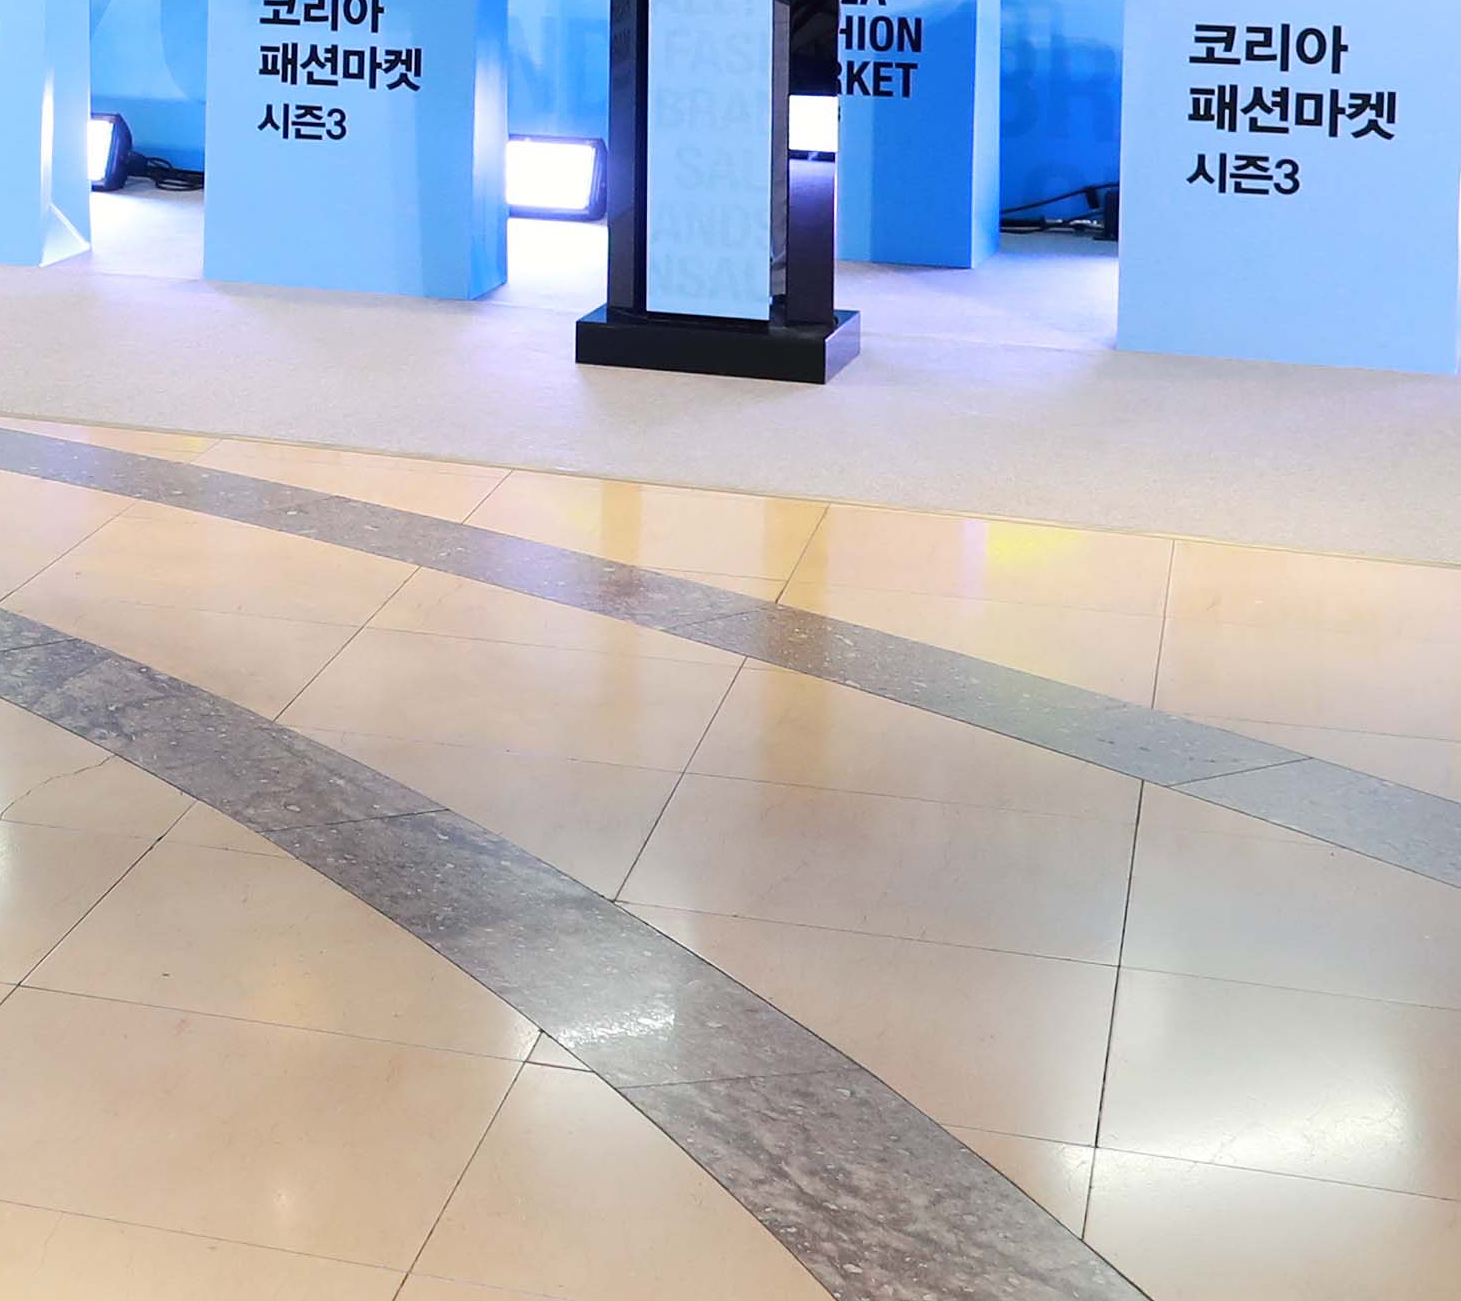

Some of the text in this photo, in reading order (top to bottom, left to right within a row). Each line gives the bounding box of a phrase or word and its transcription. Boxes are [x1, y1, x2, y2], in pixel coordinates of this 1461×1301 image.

[258, 42, 422, 92] 패션마켓
[1189, 23, 1349, 74] 코리아
[257, 103, 347, 140] 시즌3
[1188, 84, 1397, 140] 패션마켓
[1186, 152, 1300, 196] 시즌3
